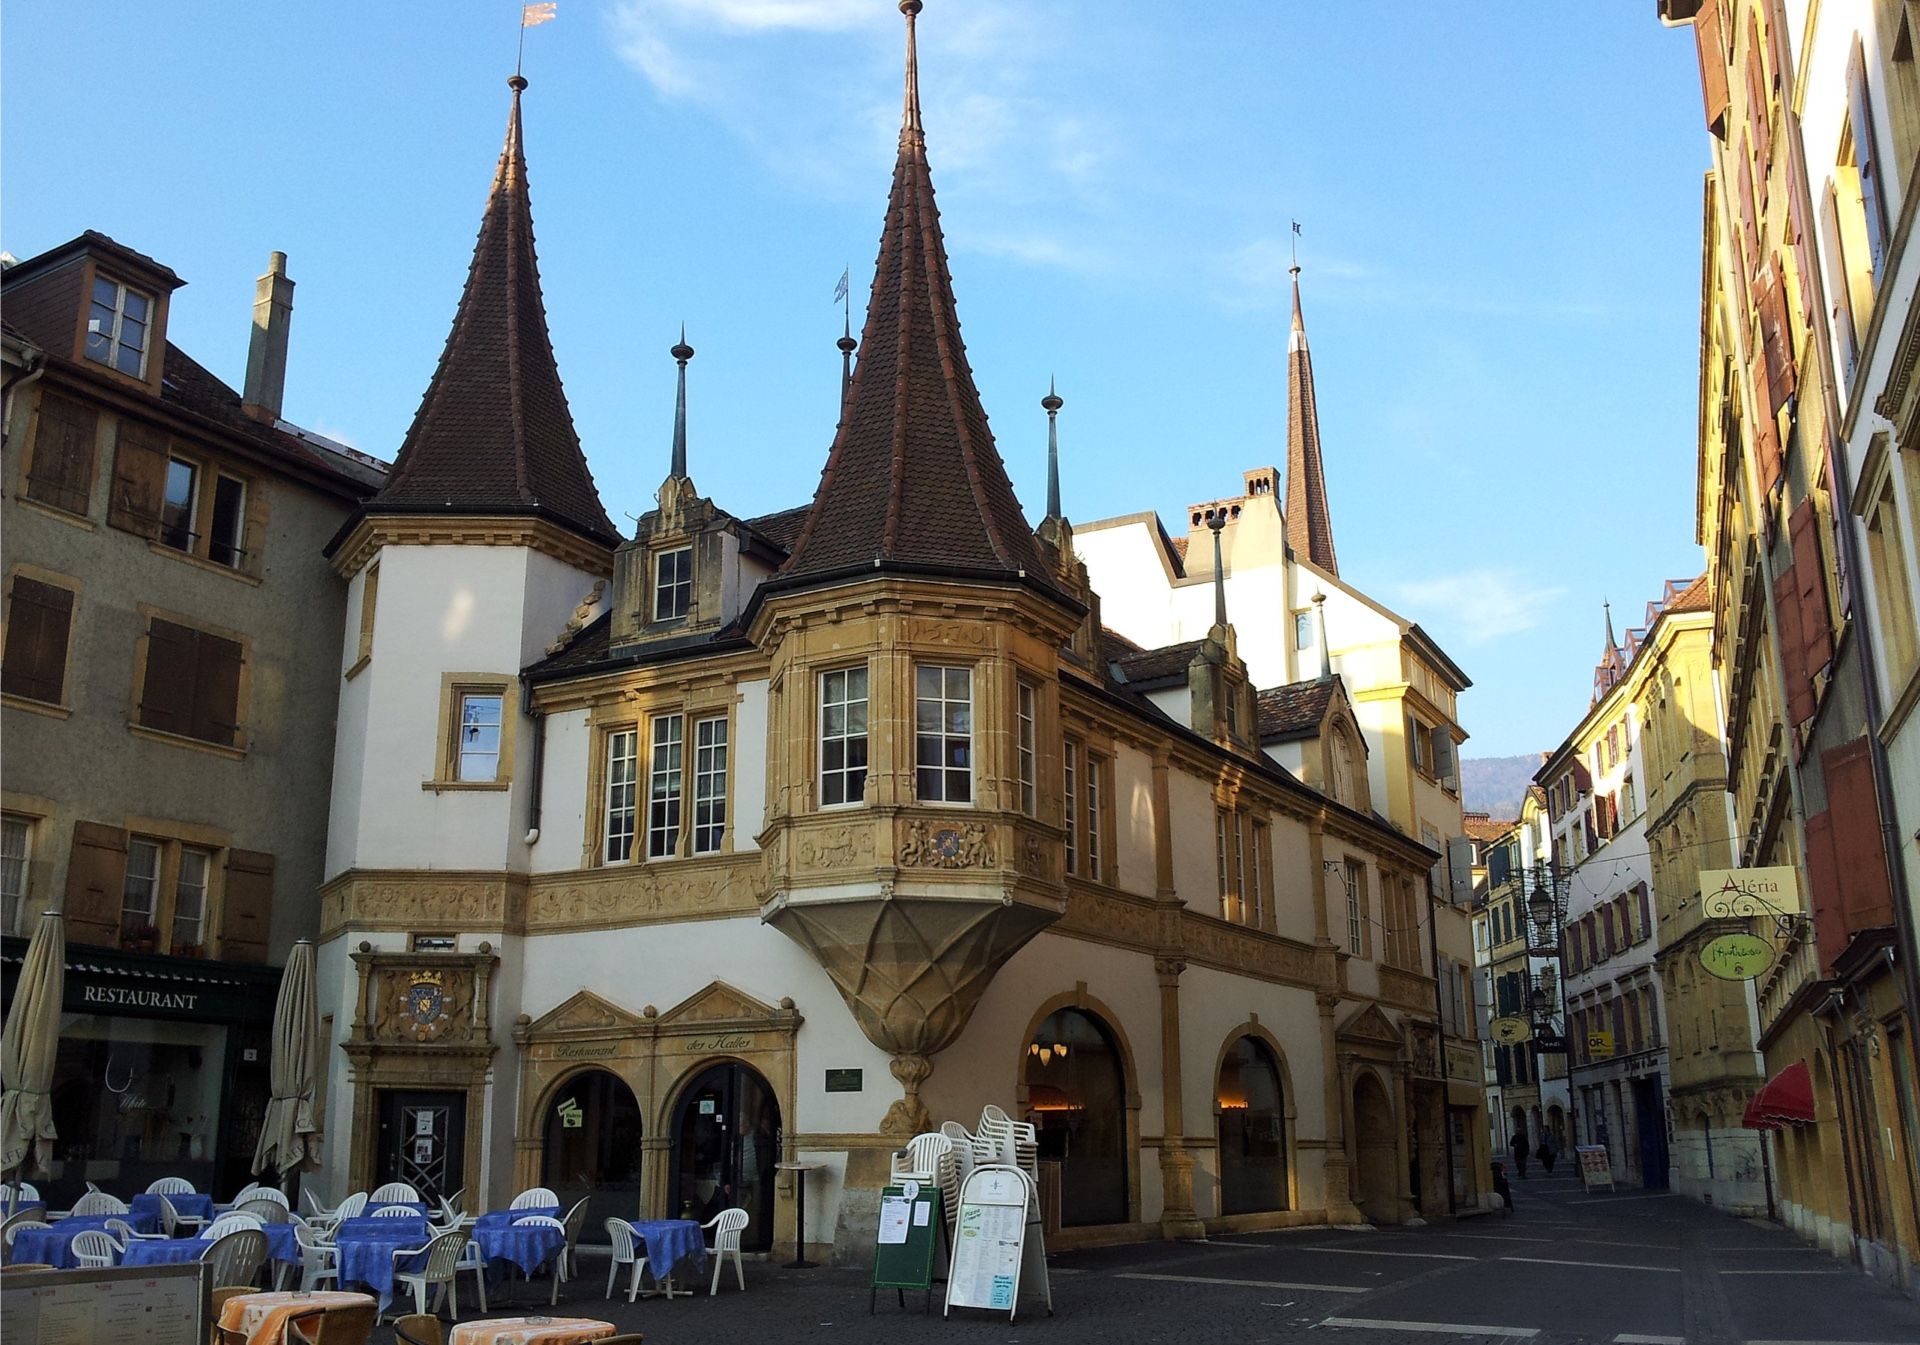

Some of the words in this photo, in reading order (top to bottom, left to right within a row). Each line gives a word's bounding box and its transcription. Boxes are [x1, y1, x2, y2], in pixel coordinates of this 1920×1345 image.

[1720, 873, 1778, 896] Aléria
[84, 986, 198, 1009] RESTAURANT
[557, 1044, 616, 1058] Restaurant
[708, 1034, 751, 1050] Halles
